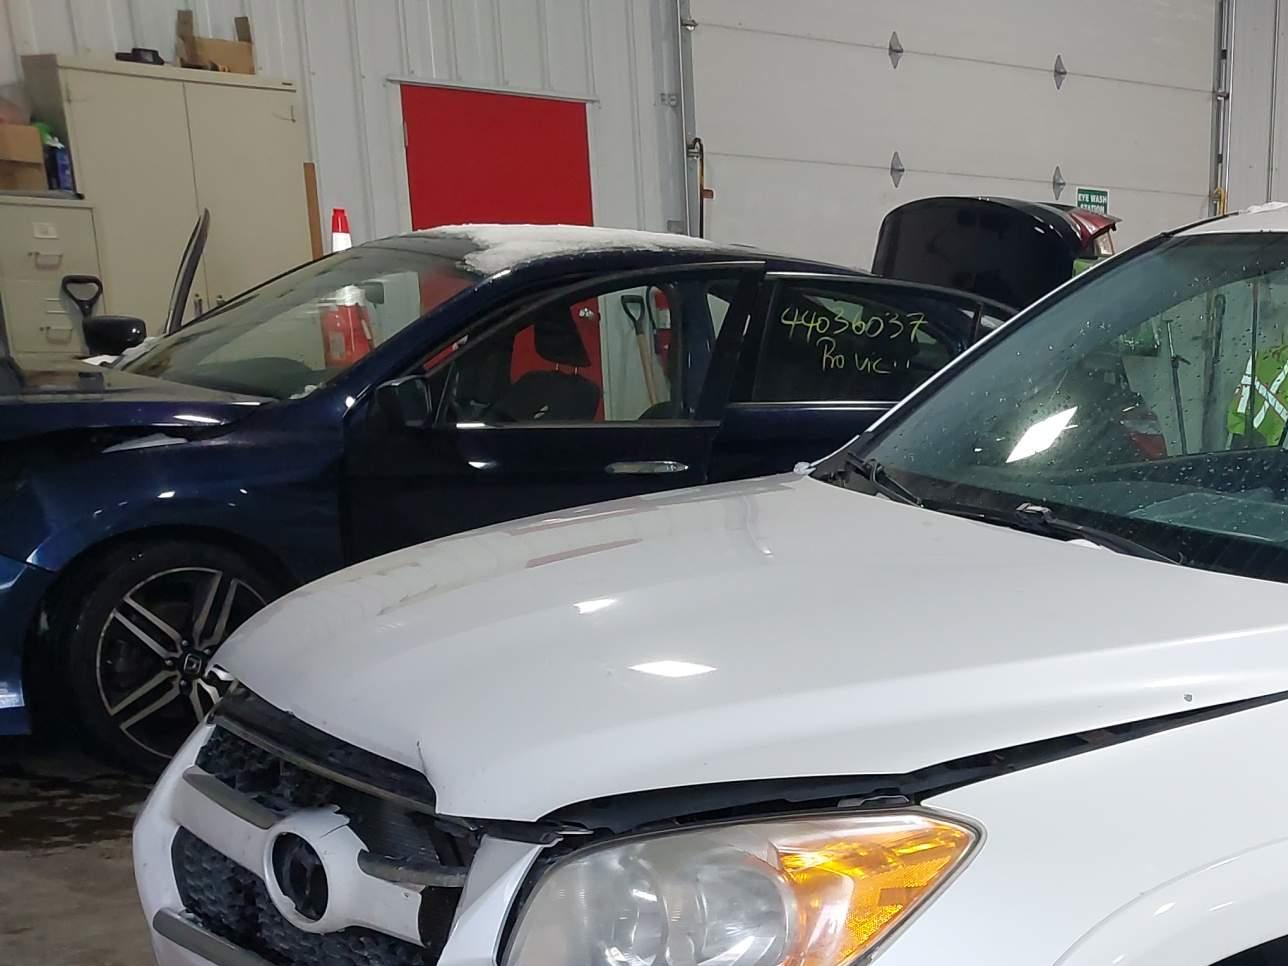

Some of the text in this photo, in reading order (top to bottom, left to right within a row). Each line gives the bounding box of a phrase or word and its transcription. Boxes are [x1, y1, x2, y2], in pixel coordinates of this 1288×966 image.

[1078, 193, 1107, 205] EYE WASH
[781, 303, 929, 343] 44036037
